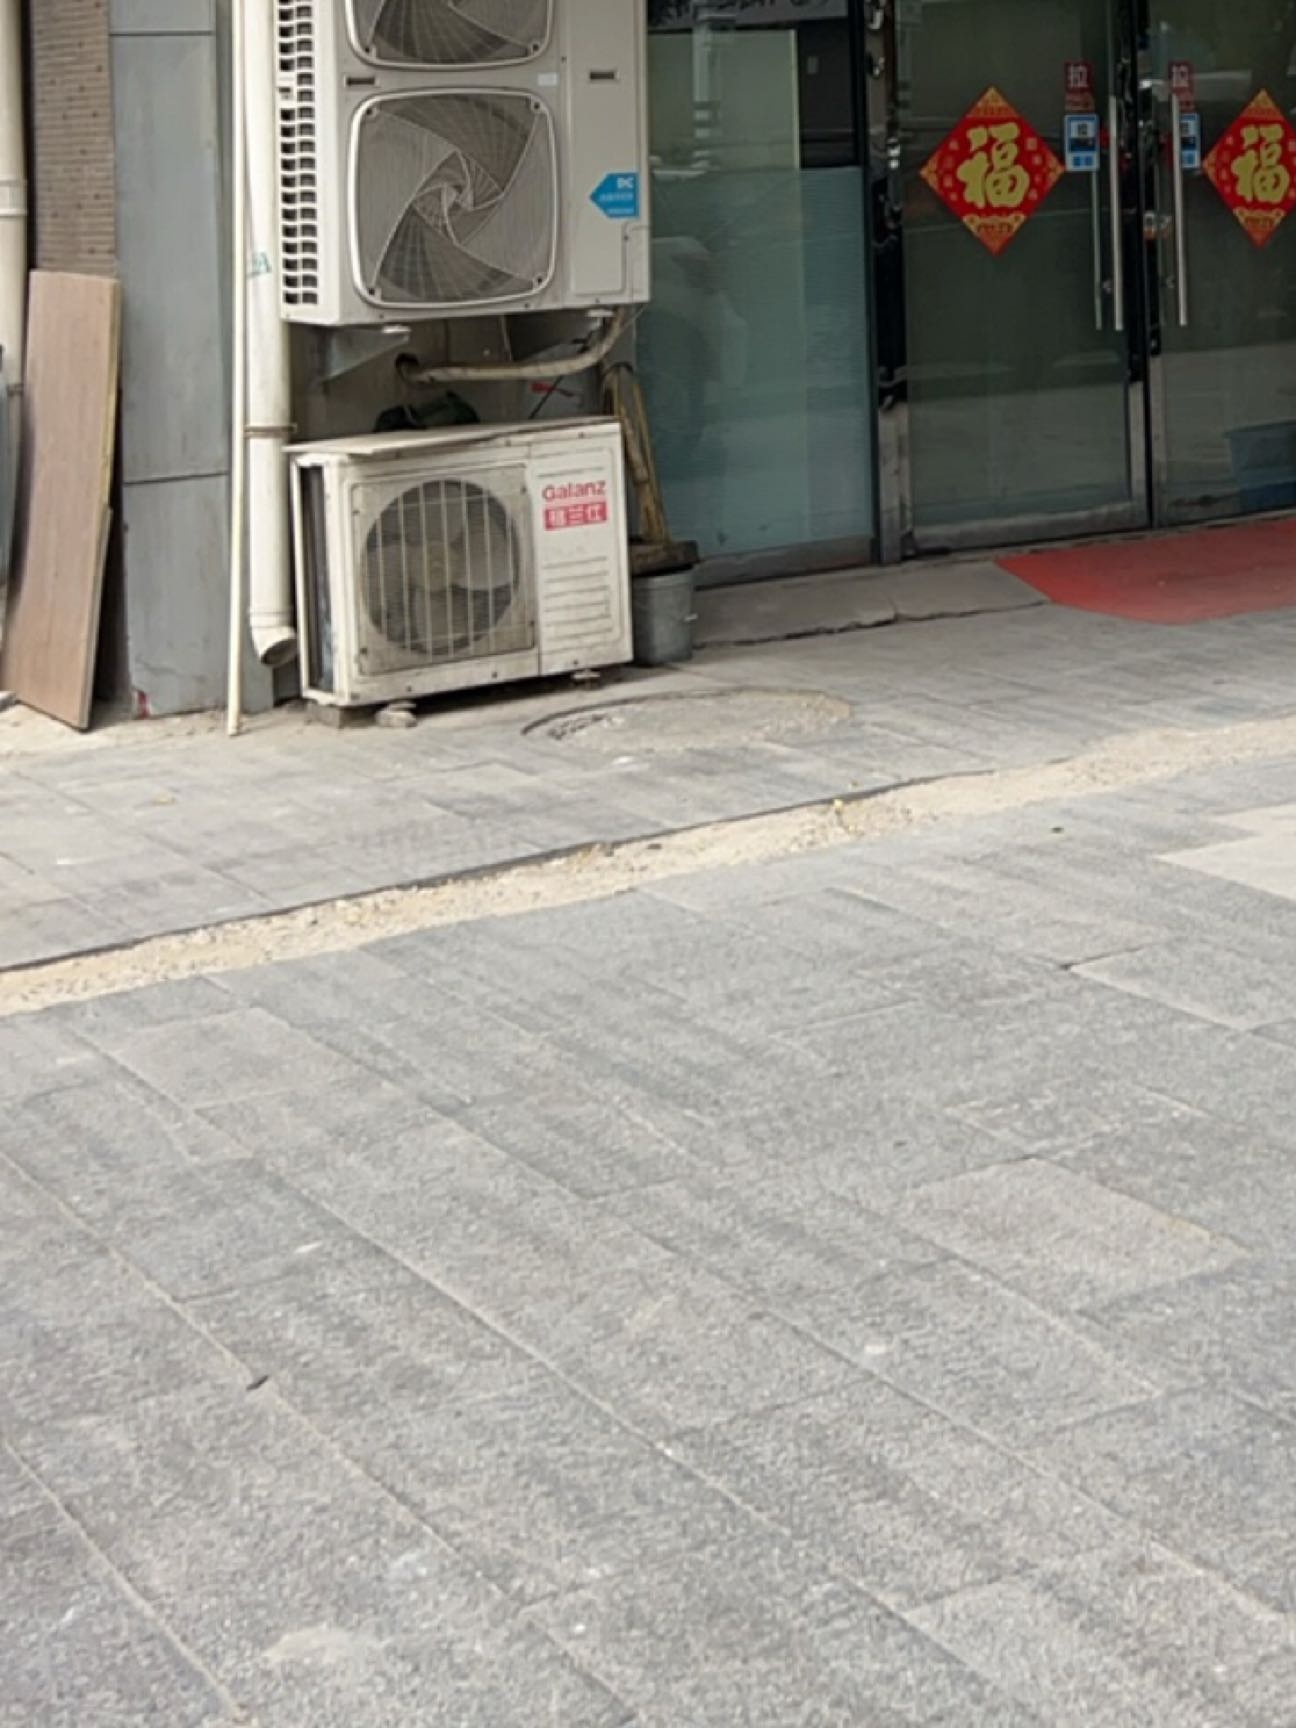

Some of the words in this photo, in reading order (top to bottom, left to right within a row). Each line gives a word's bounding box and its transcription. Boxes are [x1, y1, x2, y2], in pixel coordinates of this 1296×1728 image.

[956, 121, 1031, 211] 福
[1230, 123, 1290, 205] 福
[542, 480, 606, 502] Galanz
